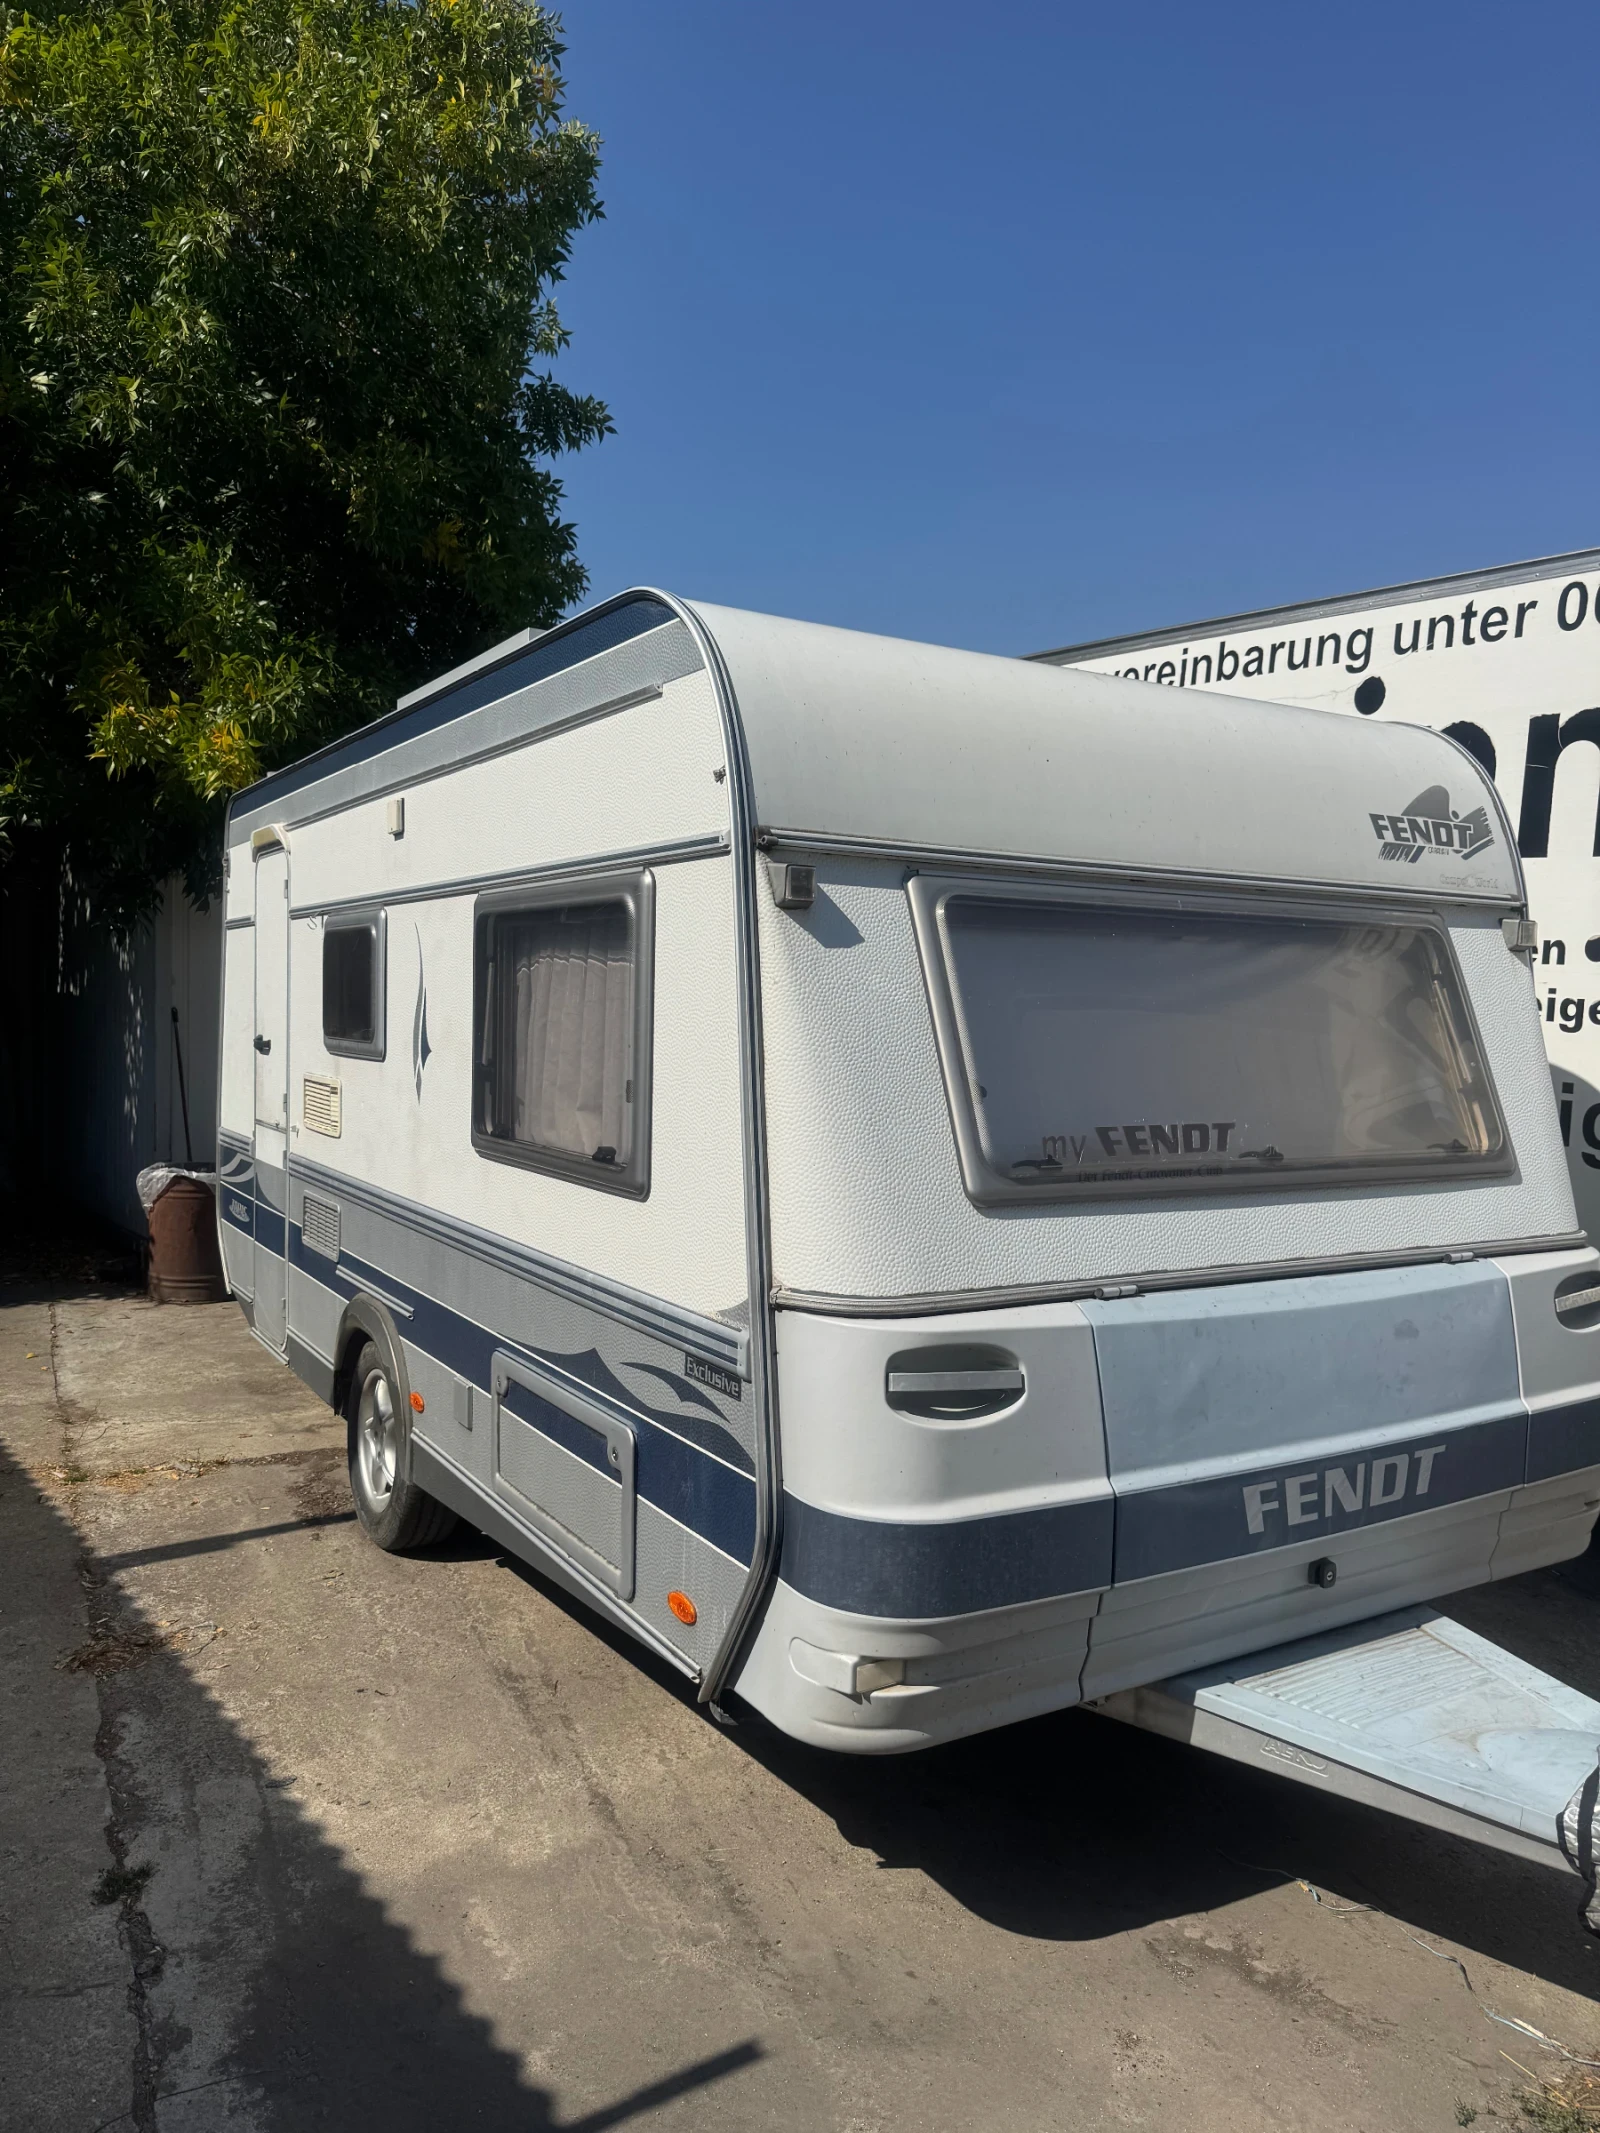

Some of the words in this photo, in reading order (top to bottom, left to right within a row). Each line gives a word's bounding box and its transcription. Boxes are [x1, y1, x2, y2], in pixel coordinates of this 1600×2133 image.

[1114, 627, 1374, 687] reinbarung
[1393, 600, 1539, 655] unter
[1557, 581, 1600, 632] 0
[1368, 813, 1472, 850] FENDT
[1042, 1134, 1087, 1164] my
[1095, 1122, 1235, 1157] FENDT
[686, 1356, 740, 1398] Exclusive
[1242, 1444, 1448, 1535] FENDT
